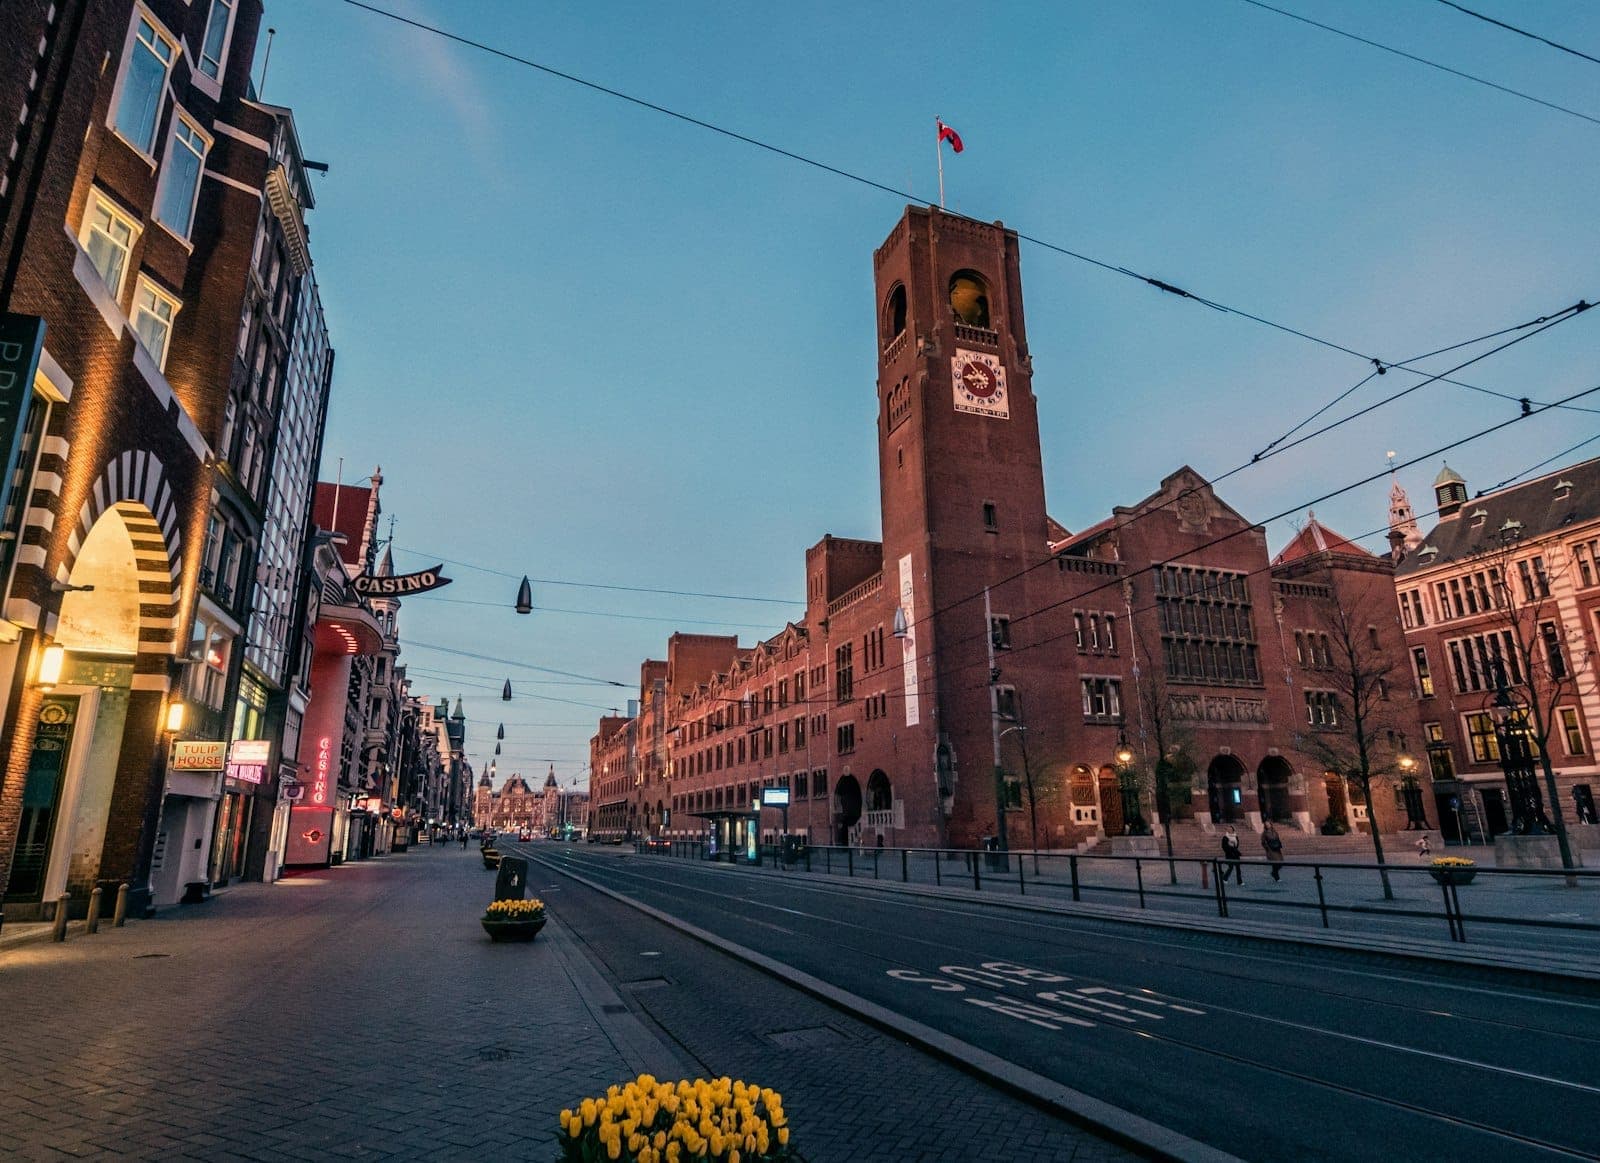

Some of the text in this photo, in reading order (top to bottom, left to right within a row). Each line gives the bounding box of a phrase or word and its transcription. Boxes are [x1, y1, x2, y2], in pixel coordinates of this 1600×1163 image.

[355, 572, 435, 593] CASINO
[184, 745, 218, 754] TULIP
[178, 756, 221, 765] HOUSE
[313, 737, 329, 803] CASINO
[886, 962, 1073, 992] BUS
